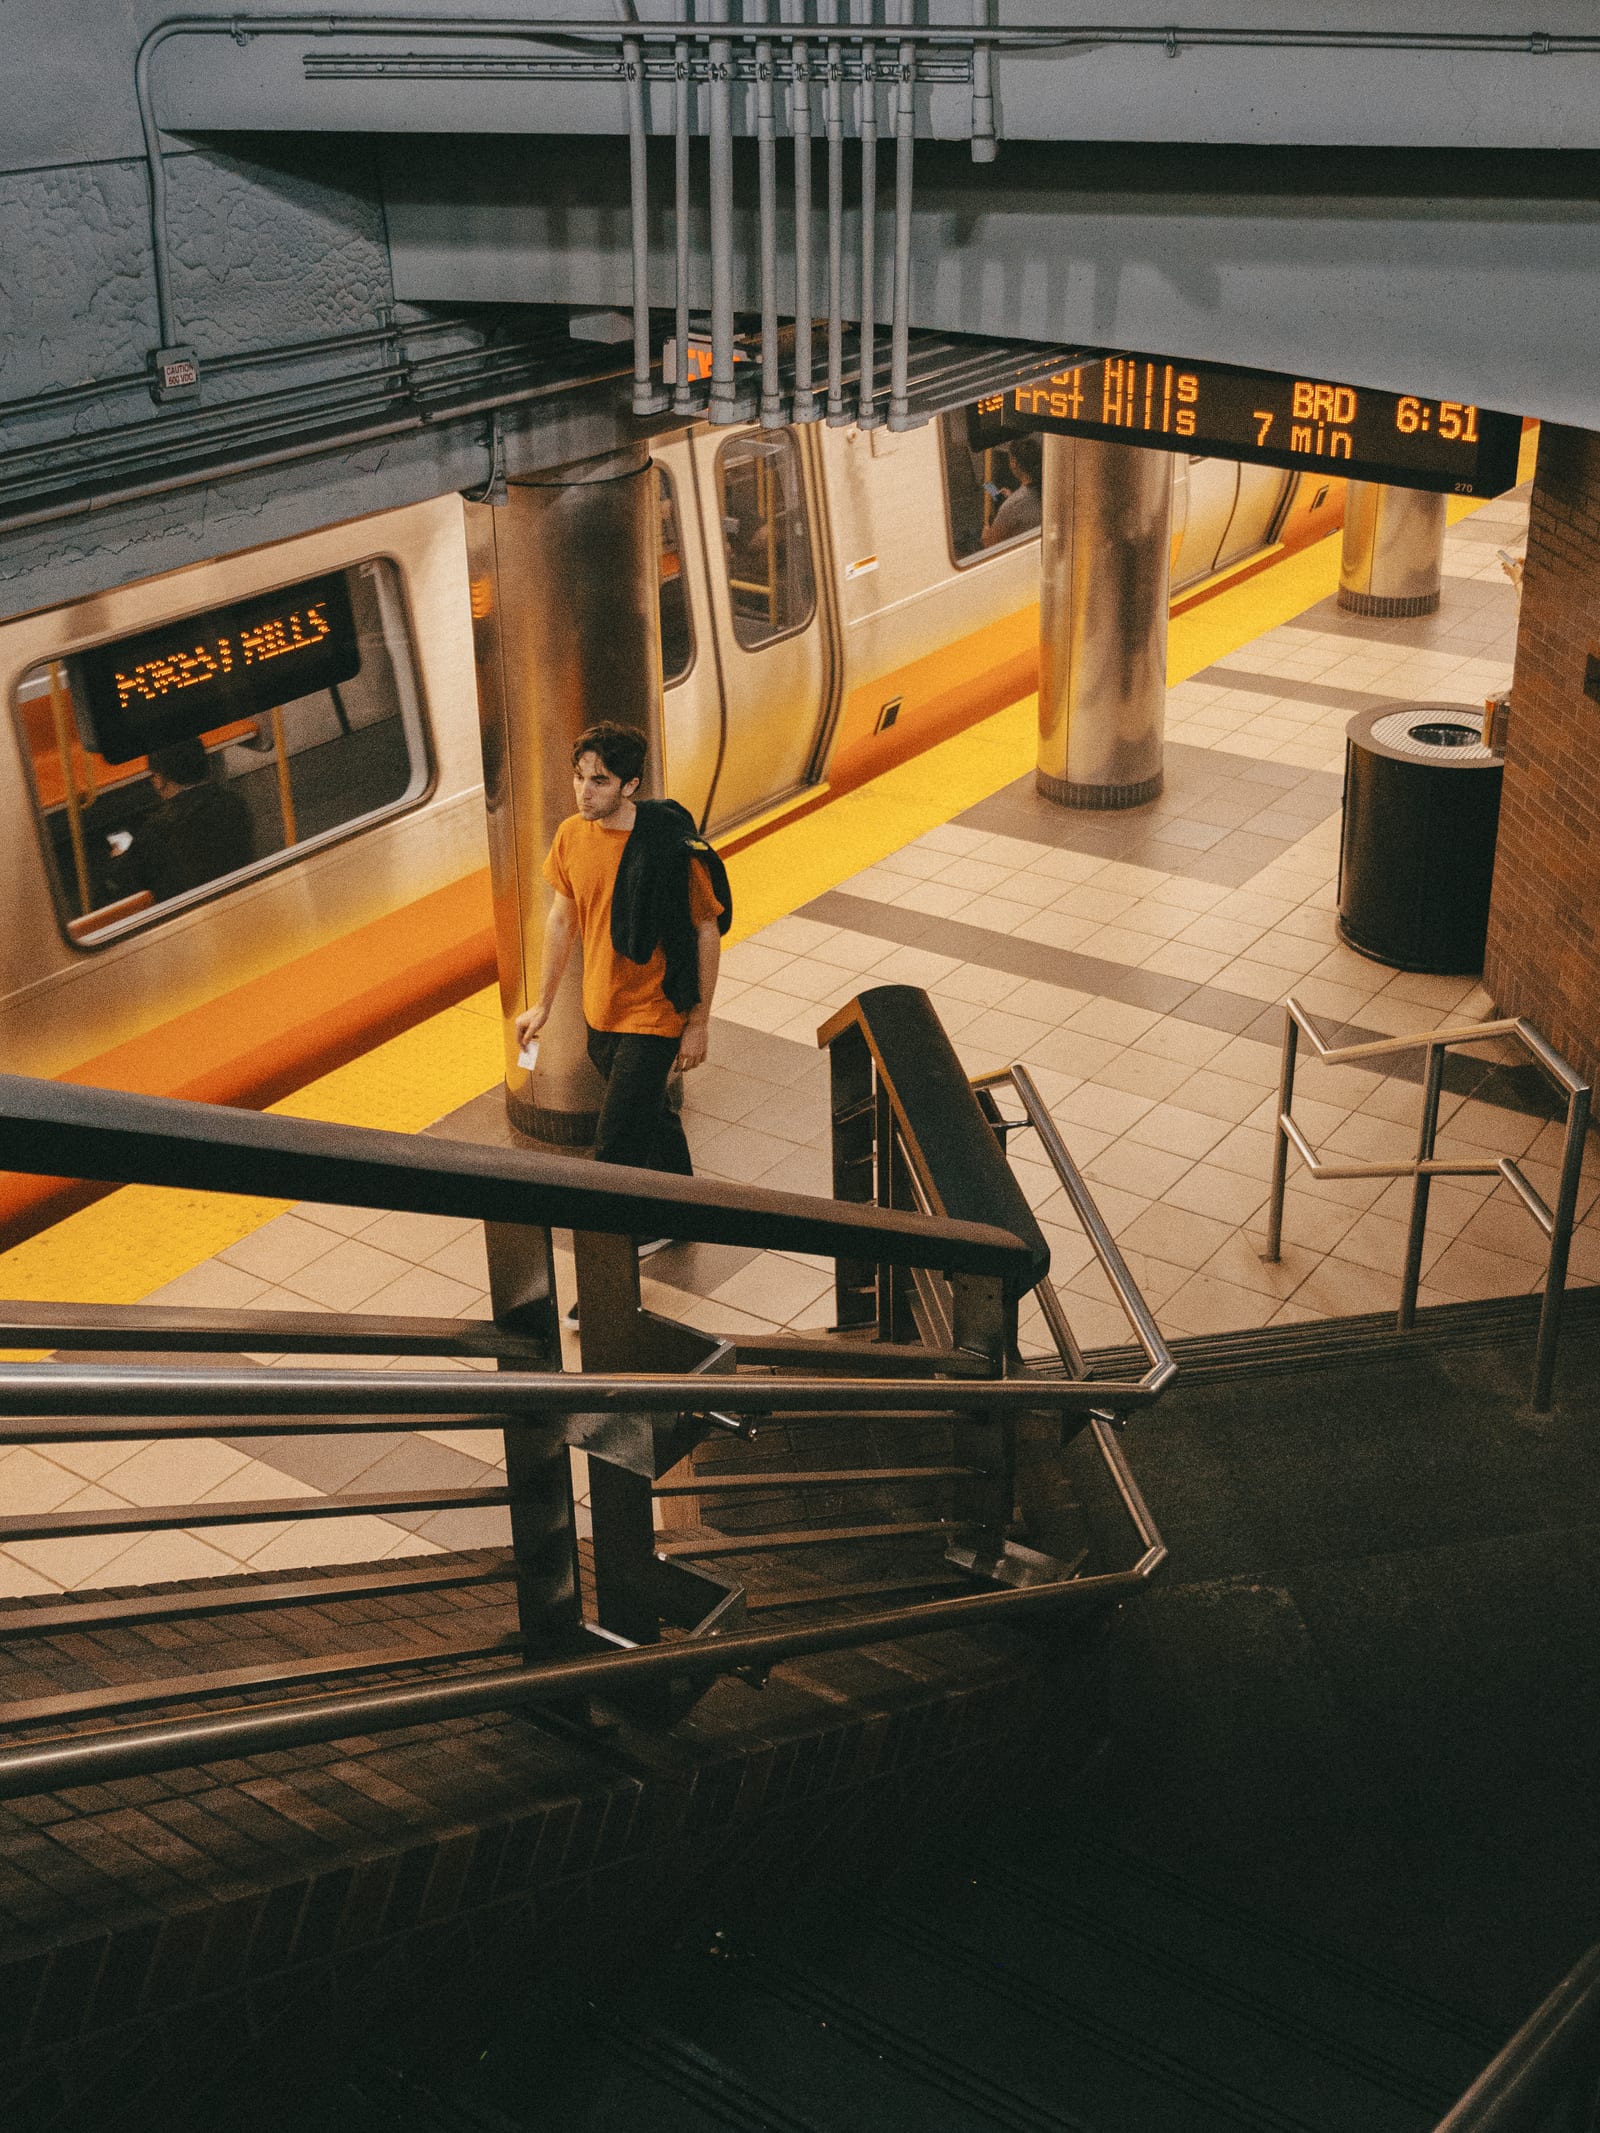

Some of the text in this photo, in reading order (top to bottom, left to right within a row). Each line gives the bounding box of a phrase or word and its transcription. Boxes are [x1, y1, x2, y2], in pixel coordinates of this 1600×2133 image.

[166, 363, 194, 376] CAUTION
[180, 372, 194, 382] VDC
[1103, 357, 1199, 403] Hills
[1291, 381, 1358, 425] BRD
[1395, 396, 1478, 443] 6:51
[1101, 390, 1197, 437] Hills
[1252, 410, 1275, 447] 7
[1289, 421, 1354, 460] min
[1454, 482, 1473, 494] 270
